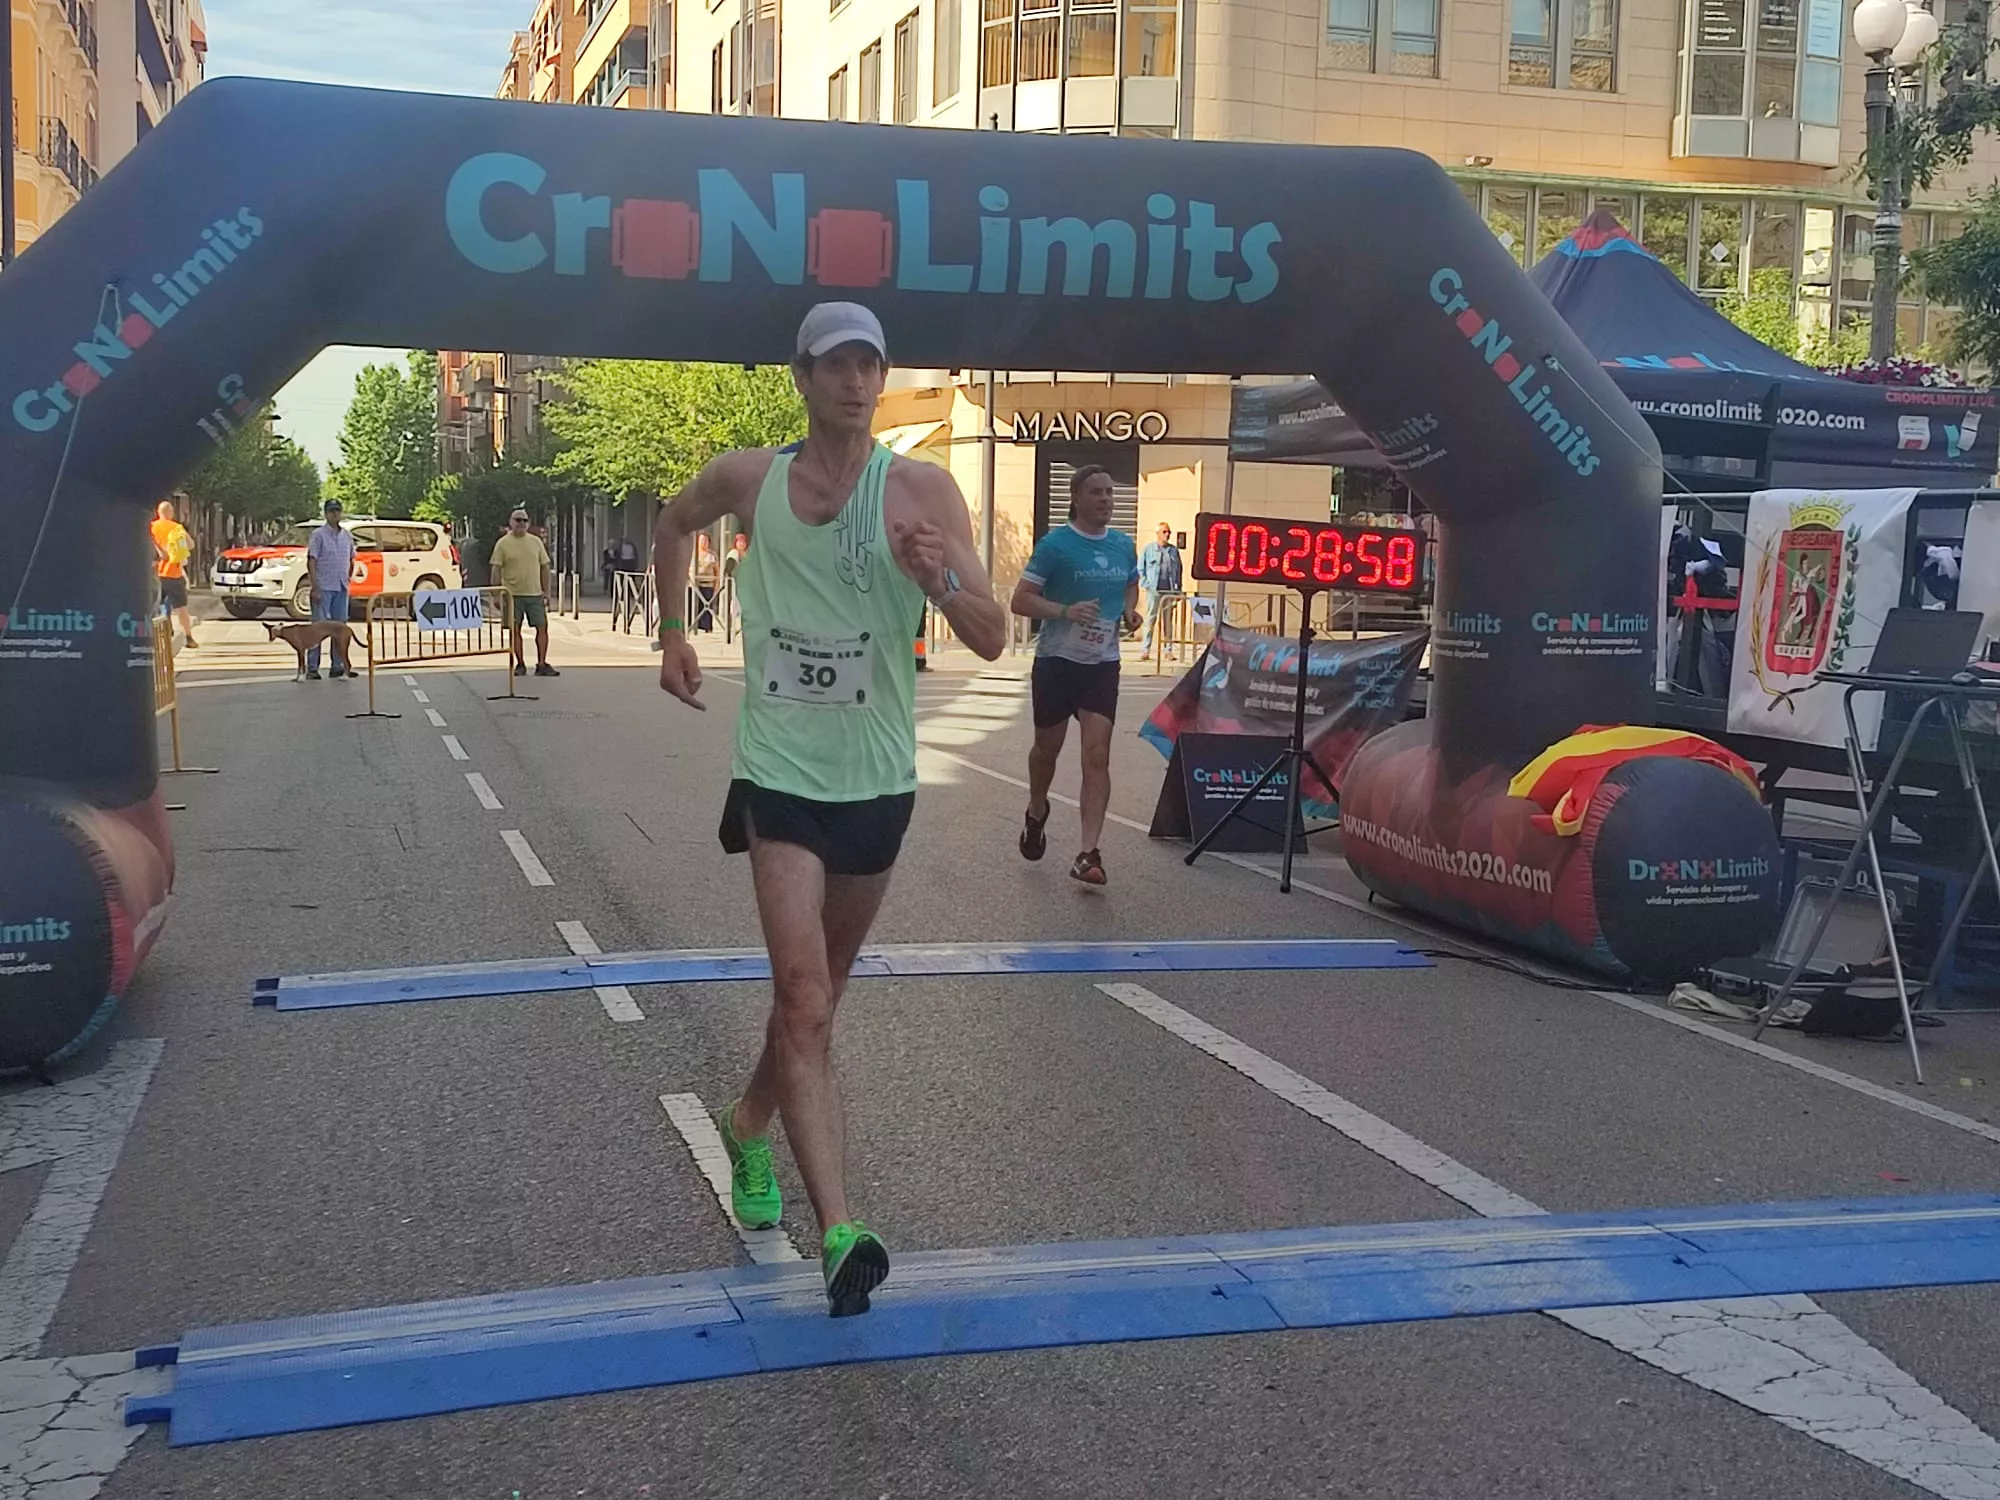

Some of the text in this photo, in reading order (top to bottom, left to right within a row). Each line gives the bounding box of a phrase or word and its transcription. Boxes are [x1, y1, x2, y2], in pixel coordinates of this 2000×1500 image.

[1011, 410, 1169, 442] MANGO
[1207, 520, 1415, 587] 00:28:58
[449, 595, 481, 620] 10K
[798, 662, 837, 688] 30
[1343, 814, 1553, 894] www.cronolimits2020.com
